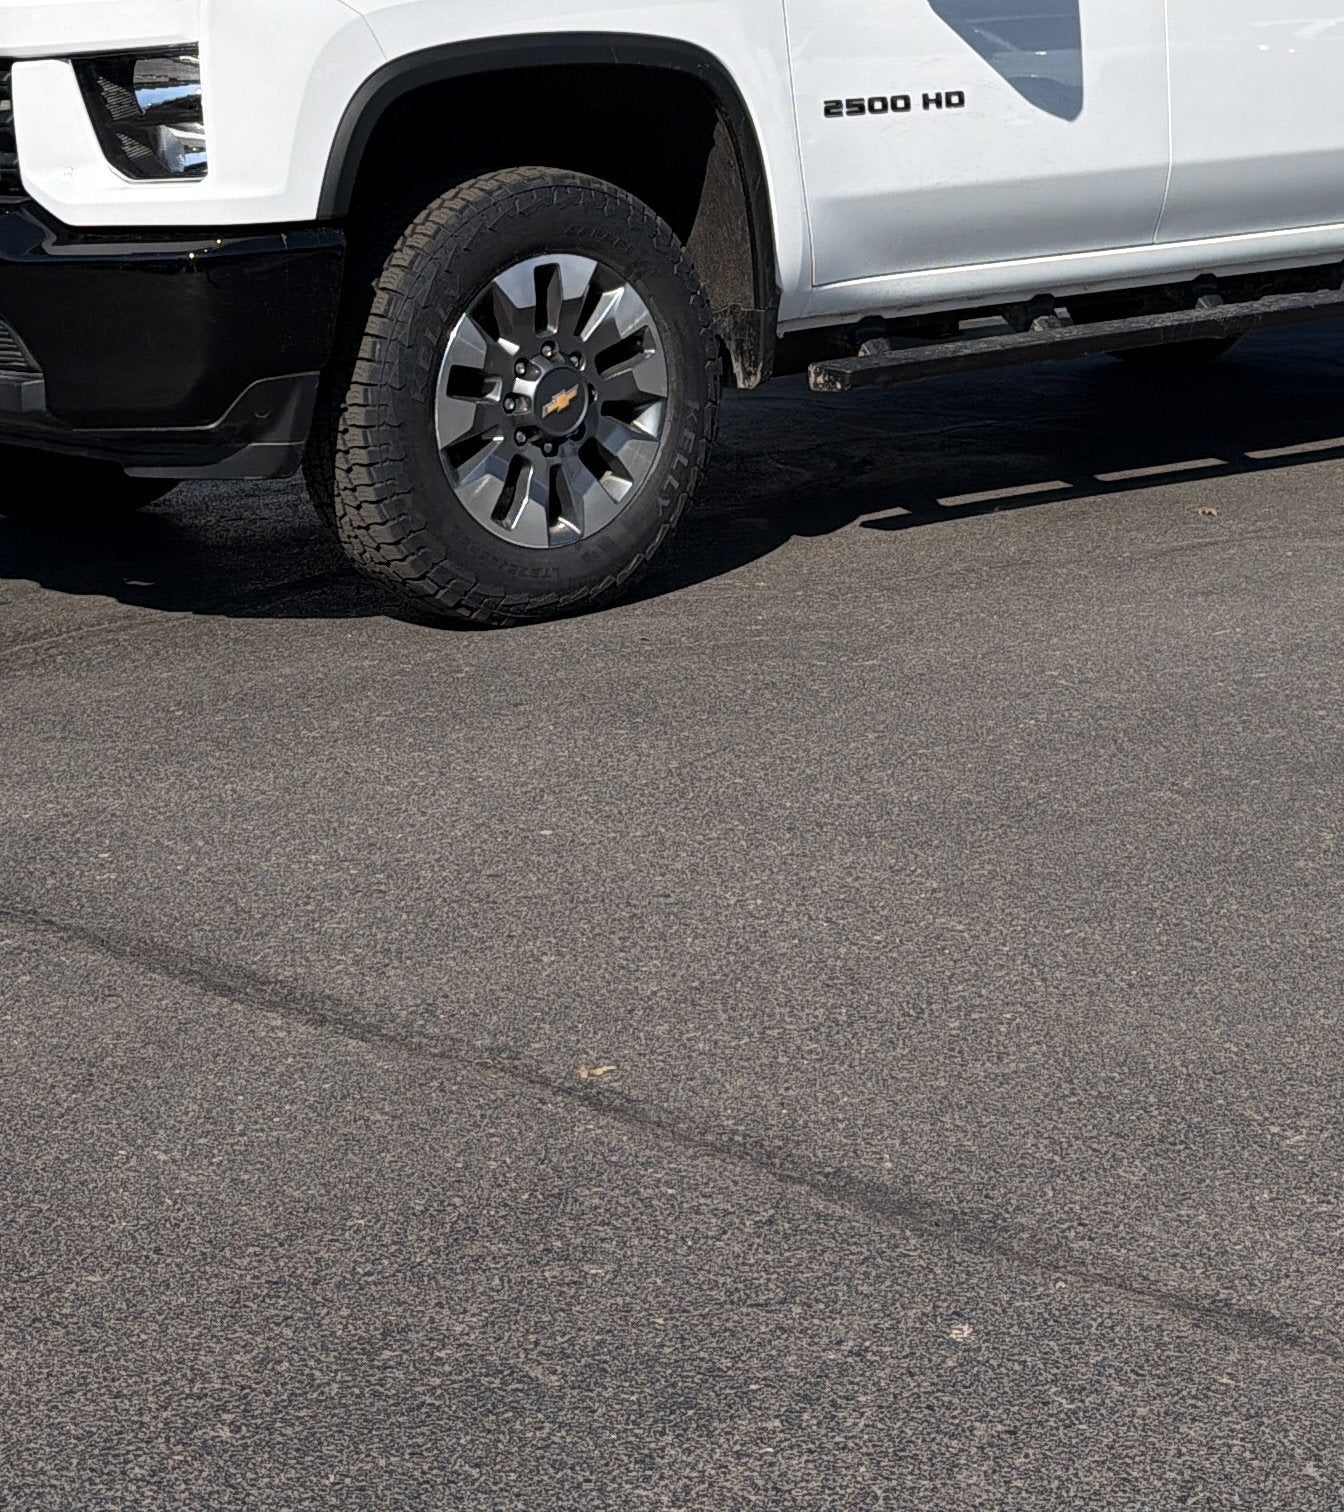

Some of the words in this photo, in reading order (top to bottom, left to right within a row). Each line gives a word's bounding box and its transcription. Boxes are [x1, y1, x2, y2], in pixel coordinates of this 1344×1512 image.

[823, 94, 912, 119] 2500
[921, 90, 966, 111] HD
[656, 399, 701, 518] KELLY
